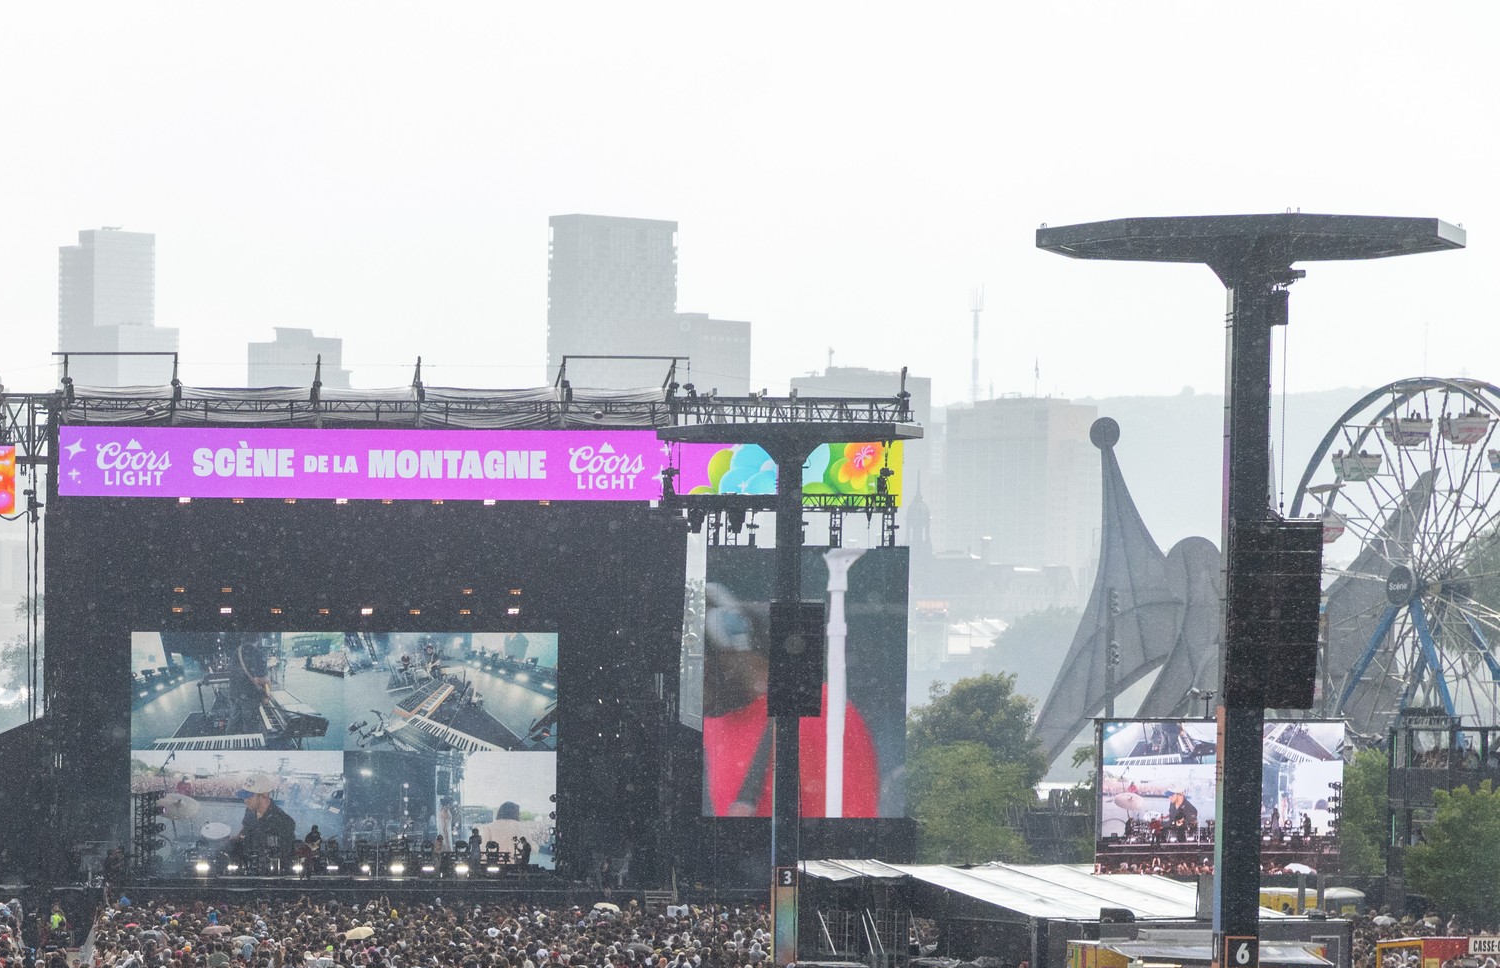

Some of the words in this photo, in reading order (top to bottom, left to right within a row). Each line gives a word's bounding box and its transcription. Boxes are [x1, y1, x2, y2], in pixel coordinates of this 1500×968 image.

[96, 441, 172, 471] Coors
[192, 440, 295, 478] SCÈNE
[303, 455, 329, 473] DE
[333, 455, 359, 473] LA
[367, 449, 547, 480] MONTAGNE
[568, 445, 645, 474] Coors
[104, 470, 163, 486] LIGHT
[577, 474, 636, 490] LIGHT
[783, 870, 792, 885] 3
[1236, 942, 1250, 965] 6
